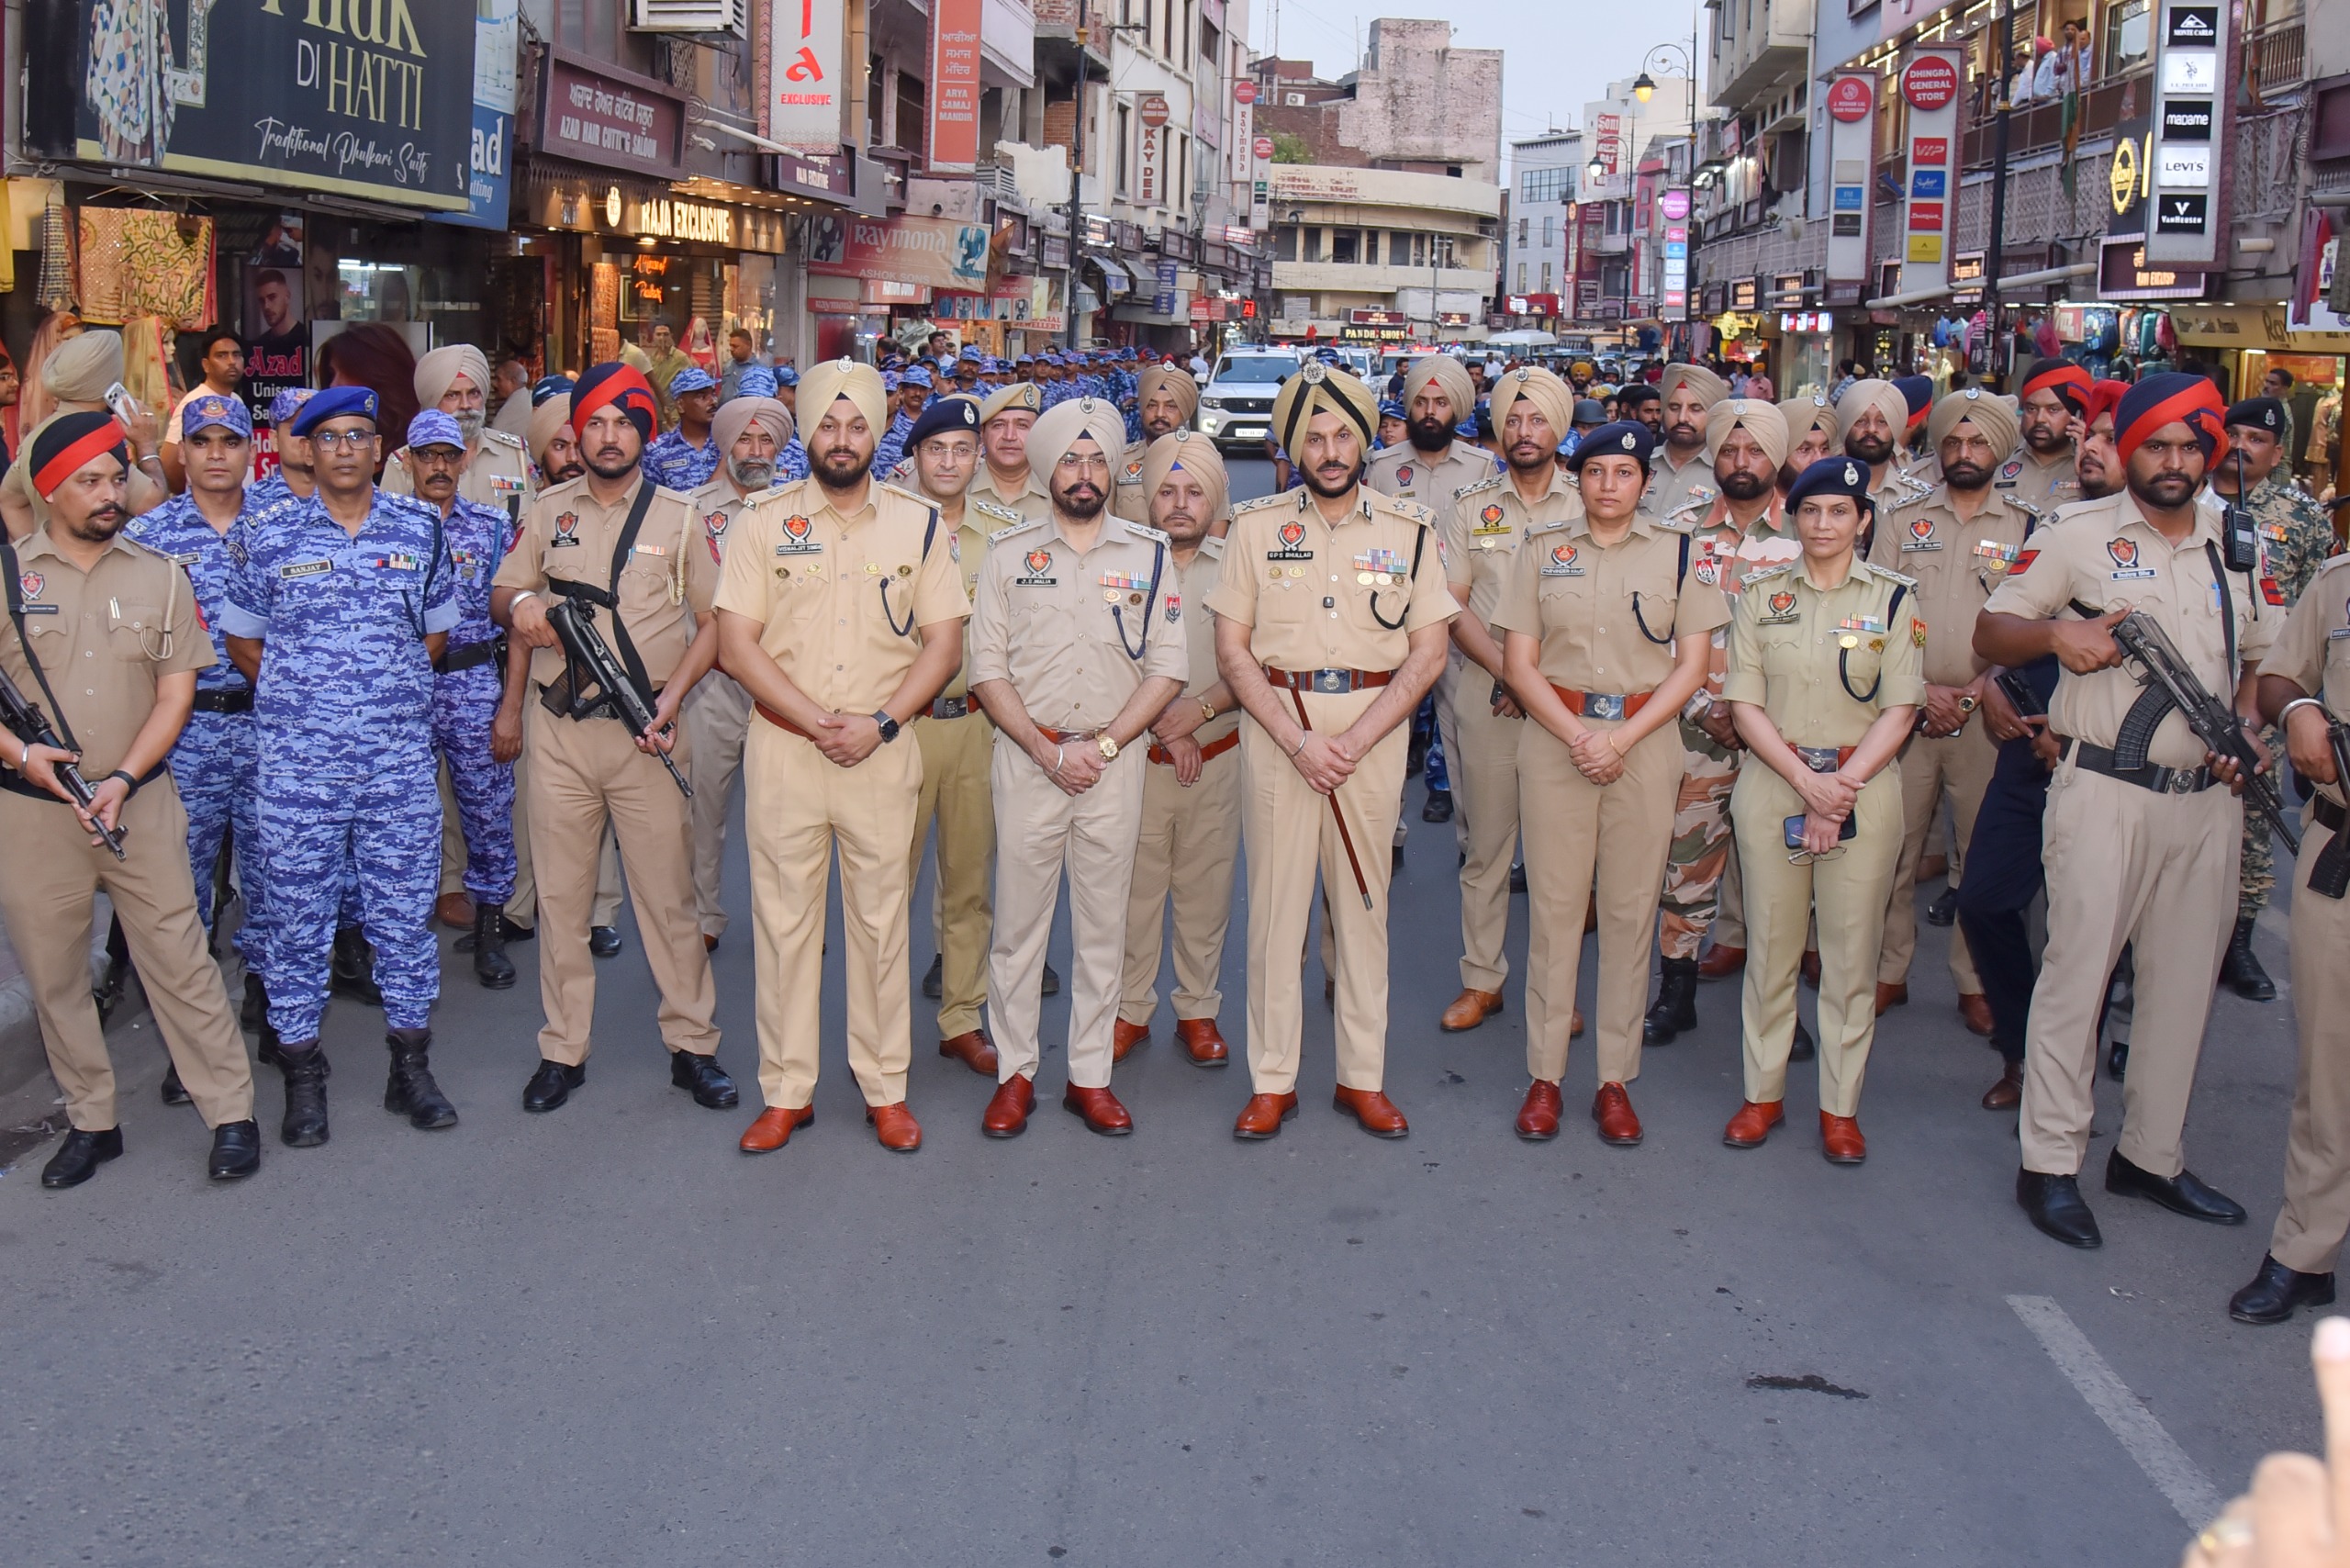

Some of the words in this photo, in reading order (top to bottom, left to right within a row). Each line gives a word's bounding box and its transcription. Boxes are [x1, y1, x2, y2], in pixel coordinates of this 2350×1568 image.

[1909, 69, 1952, 79] DHINGRA
[297, 39, 320, 89] DI
[327, 41, 423, 130] HATTI
[1909, 81, 1952, 90] GENERAL
[946, 89, 968, 98] ARYA
[1916, 92, 1945, 101] STORE
[781, 94, 832, 105] EXCLUSIVE
[942, 100, 971, 109] SAMAJ
[939, 111, 973, 121] MANDIR
[560, 115, 580, 140] AZAD
[582, 121, 599, 146] HAIR
[254, 117, 330, 162] Traditional
[333, 131, 393, 174] Phulkari
[394, 142, 431, 184] Suits
[1916, 145, 1944, 156] VIP
[643, 198, 672, 237] RAJA
[674, 201, 730, 243] EXCLUSIVE
[855, 223, 946, 253] Raymond
[859, 268, 897, 281] ASHOK
[900, 274, 931, 284] SONS
[1381, 330, 1405, 340] SHOES
[244, 345, 303, 377] Azad
[290, 565, 321, 575] SANJAY
